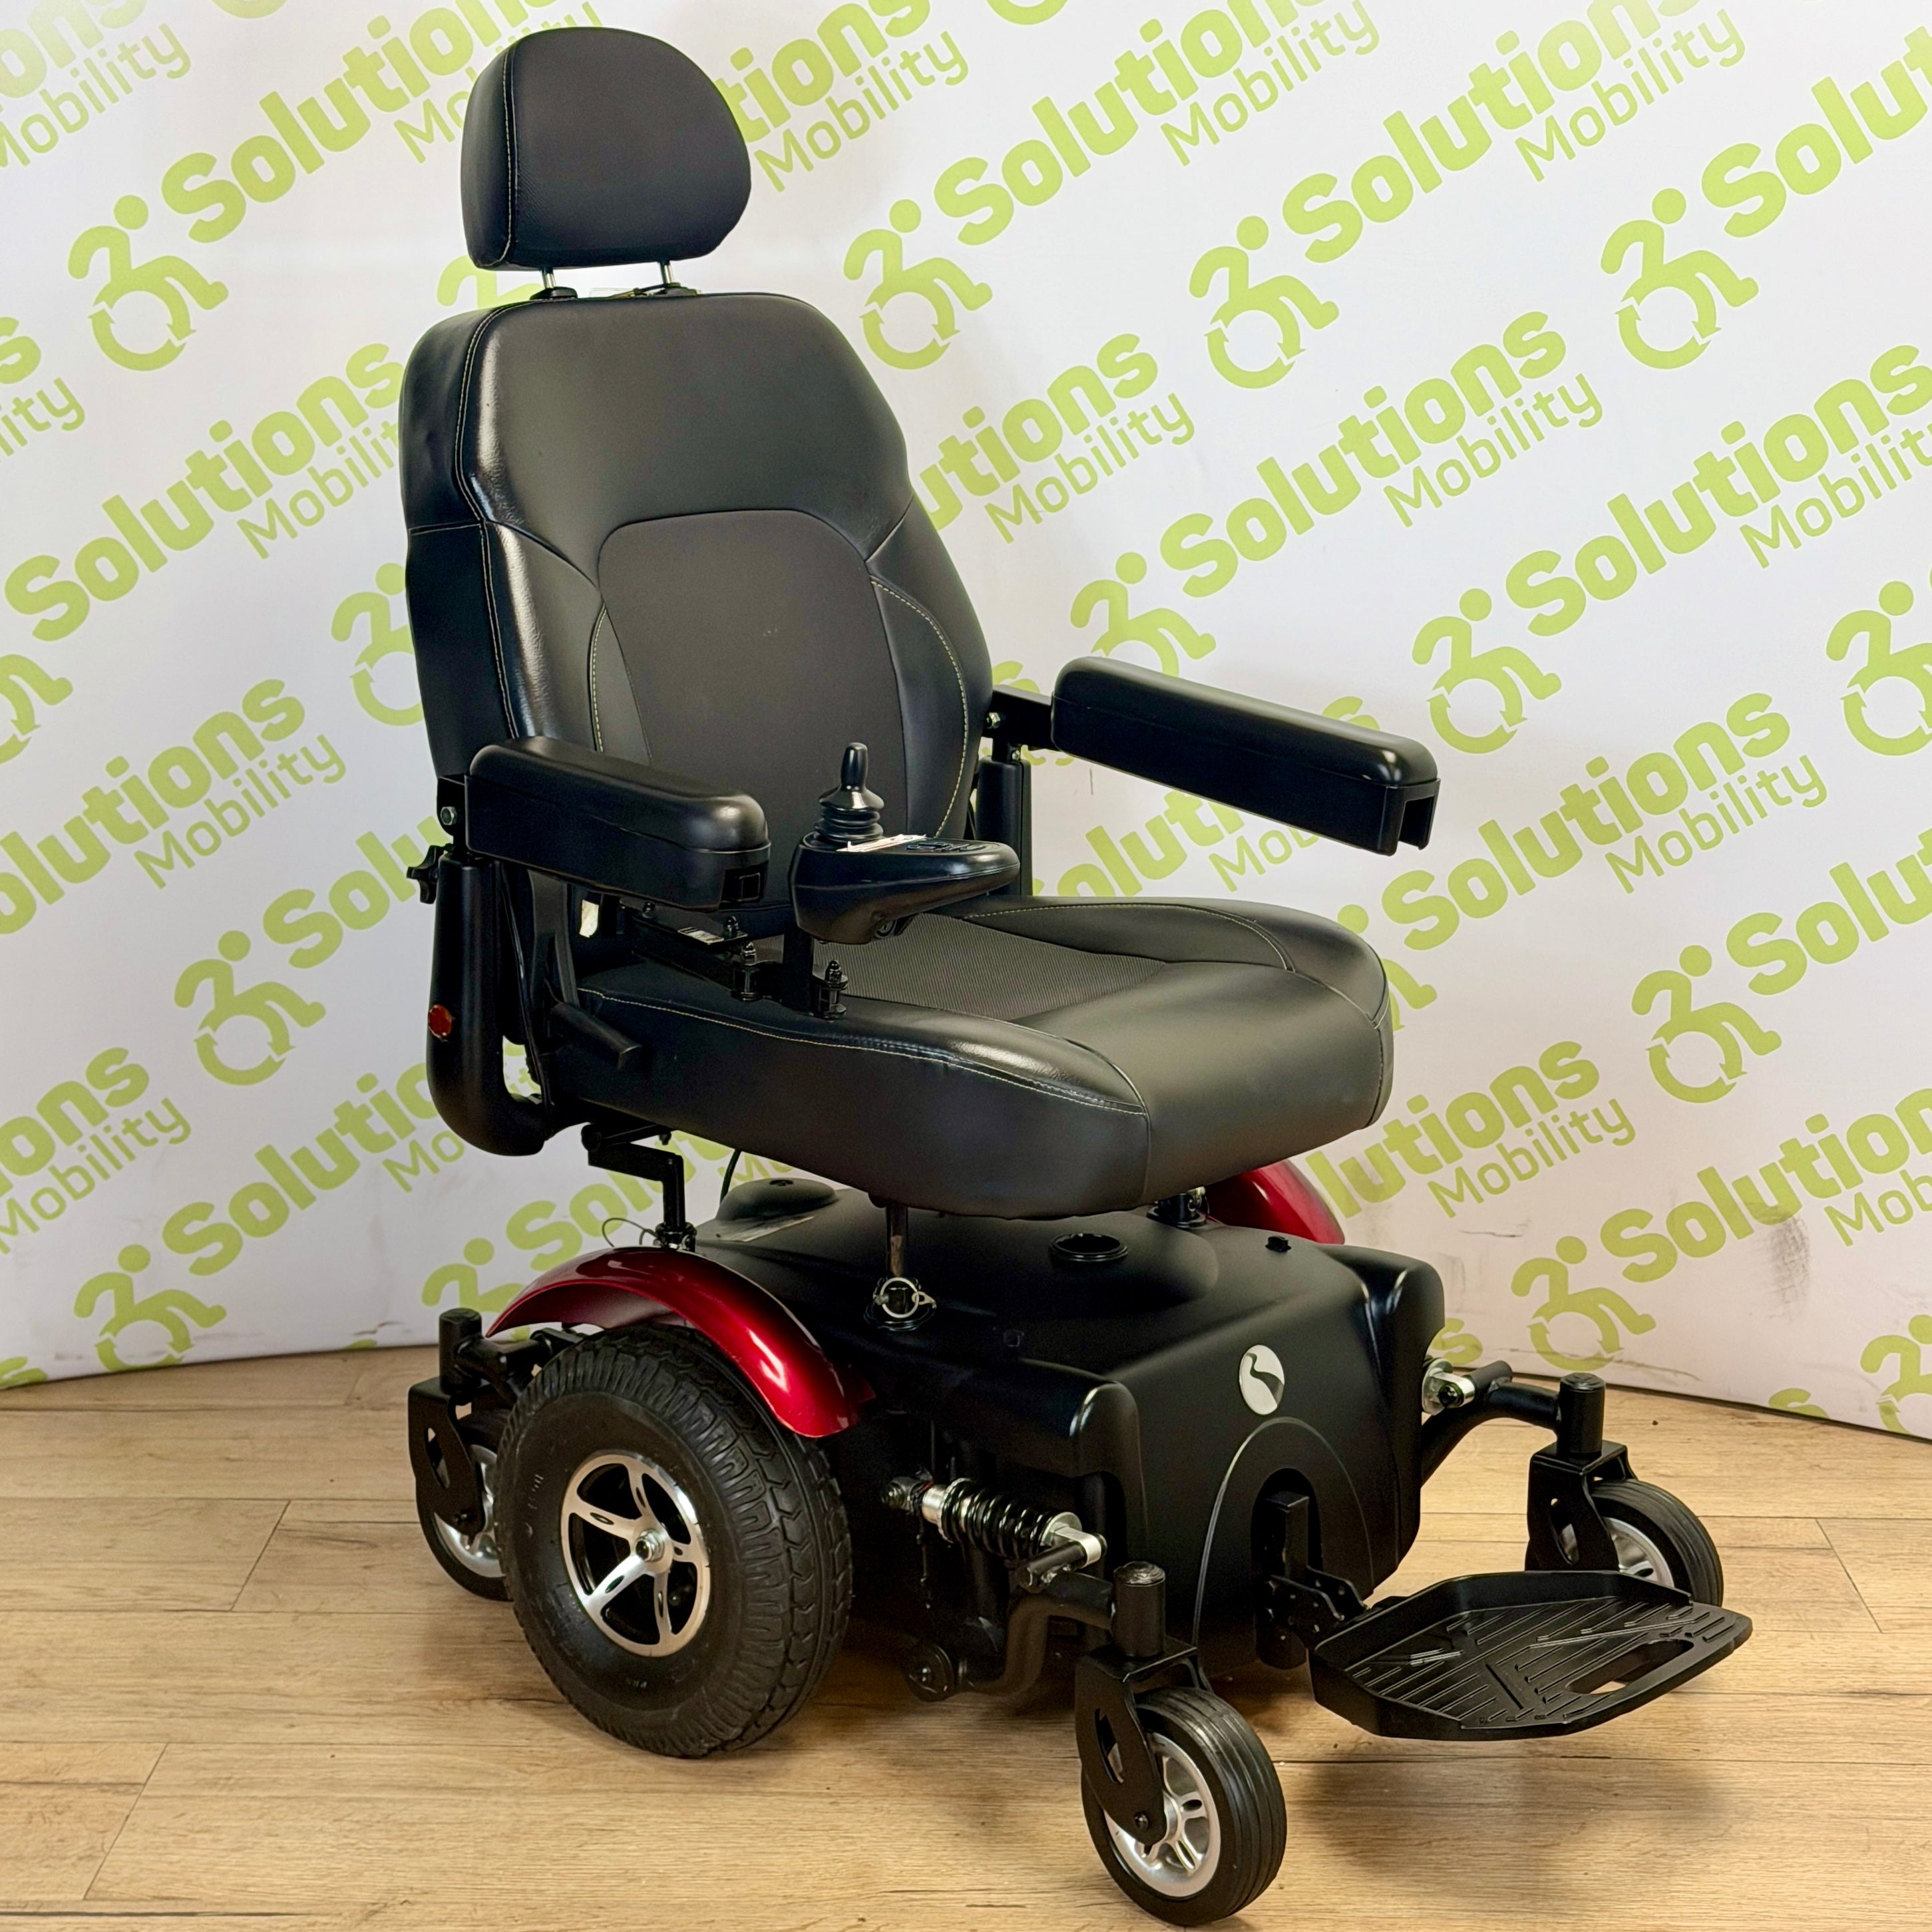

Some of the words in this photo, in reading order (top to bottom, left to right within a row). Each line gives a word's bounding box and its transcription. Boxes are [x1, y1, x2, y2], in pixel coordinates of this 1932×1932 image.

[161, 0, 556, 243] Solution
[754, 32, 968, 192] Mobility
[934, 0, 1322, 246] Solution
[1161, 0, 1380, 166] Mobility
[1282, 0, 1697, 263] Solution
[1515, 11, 1745, 181] Mobility
[4, 343, 405, 642] Solutions
[984, 394, 1194, 543] Mobility
[1160, 311, 1566, 598] Solutions
[1384, 375, 1602, 527] Mobility
[1505, 345, 1932, 637] Solutions
[134, 735, 345, 888] Mobility
[1382, 693, 1790, 950] Solutions
[1605, 756, 1827, 894] Mobility
[1726, 828, 1932, 997] Solu
[1427, 1099, 1636, 1219] Mobility
